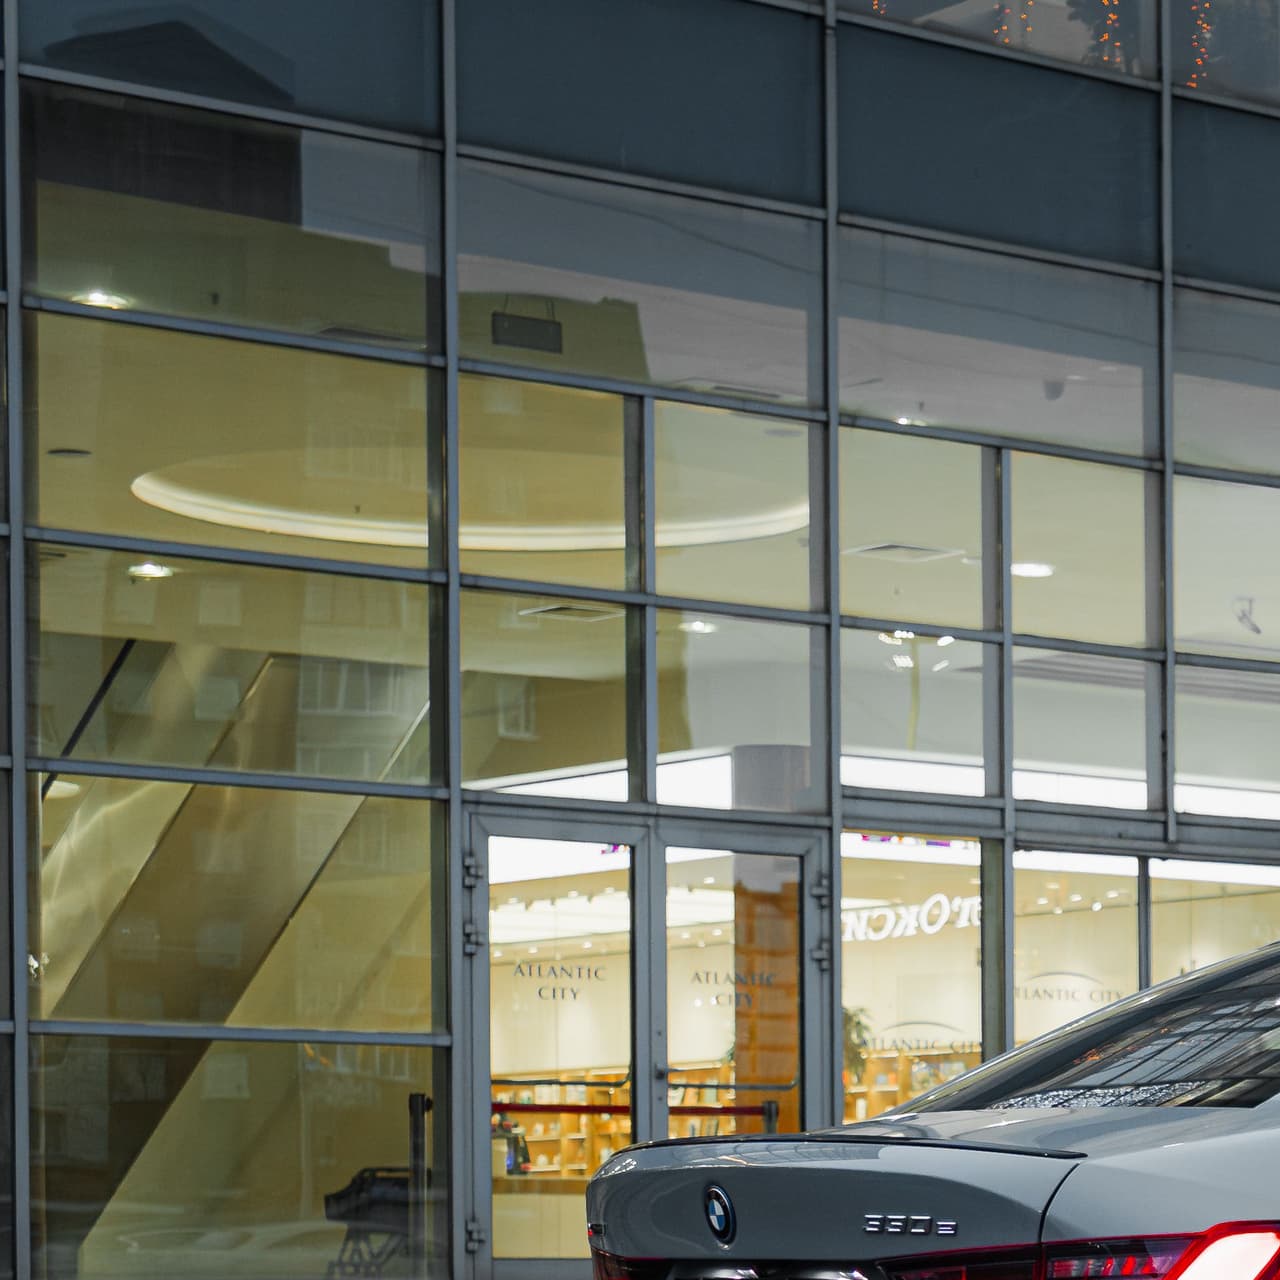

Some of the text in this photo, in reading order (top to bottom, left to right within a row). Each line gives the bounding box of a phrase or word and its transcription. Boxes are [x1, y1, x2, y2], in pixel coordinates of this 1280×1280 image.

[513, 962, 607, 982] ATLANTIC
[690, 971, 778, 986] ATLANTIC
[537, 986, 581, 1001] CITY
[715, 992, 754, 1008] CITY
